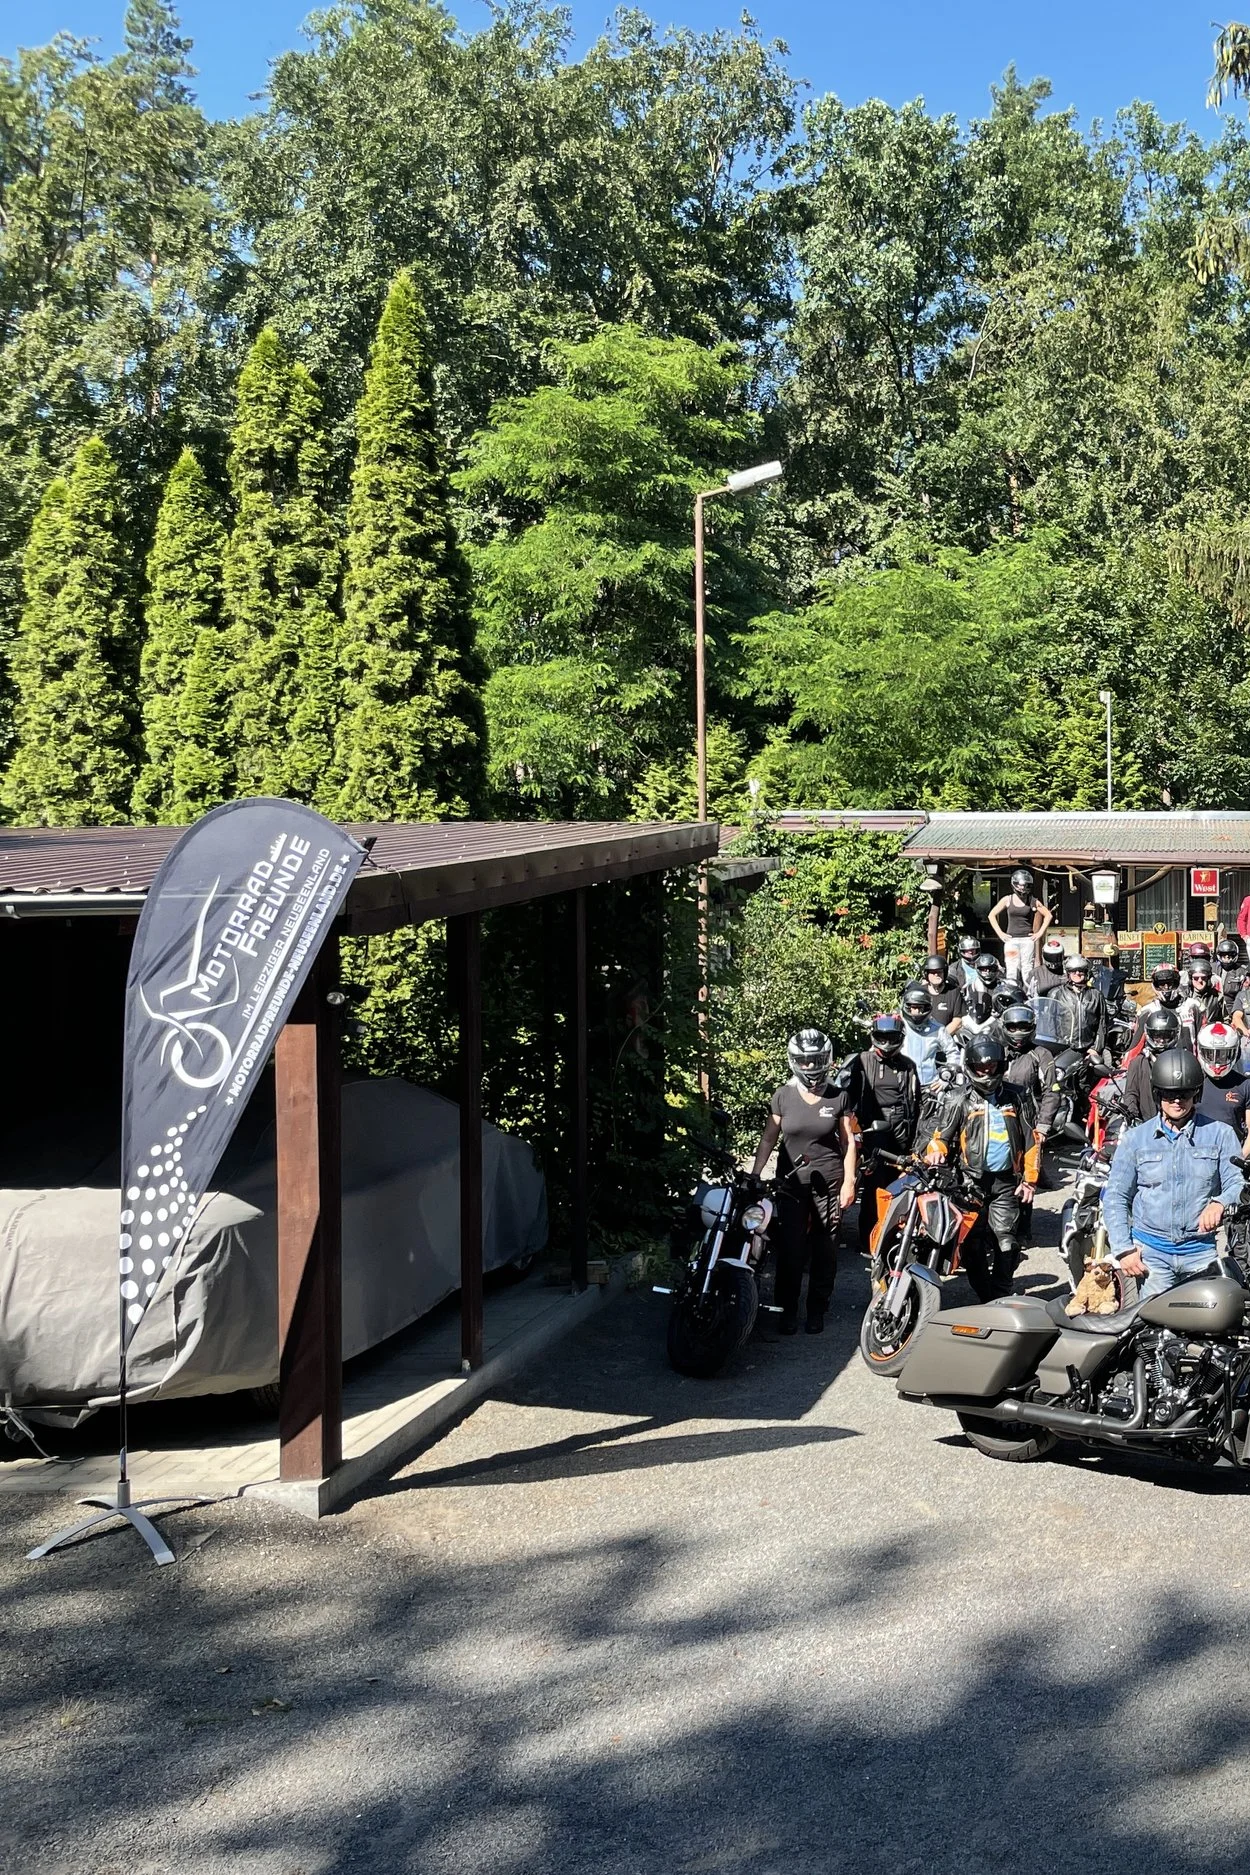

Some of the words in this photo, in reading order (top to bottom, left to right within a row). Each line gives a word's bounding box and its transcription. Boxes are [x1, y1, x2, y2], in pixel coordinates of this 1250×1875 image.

[1194, 883, 1216, 892] West
[242, 1006, 255, 1019] IM
[249, 939, 285, 1006] LEIPZIGER
[281, 848, 330, 937] NEUSEENLAND
[1183, 933, 1212, 942] CABINET
[228, 864, 347, 1097] MOTORRADFREUNDE-NEUSEENLAND.DE
